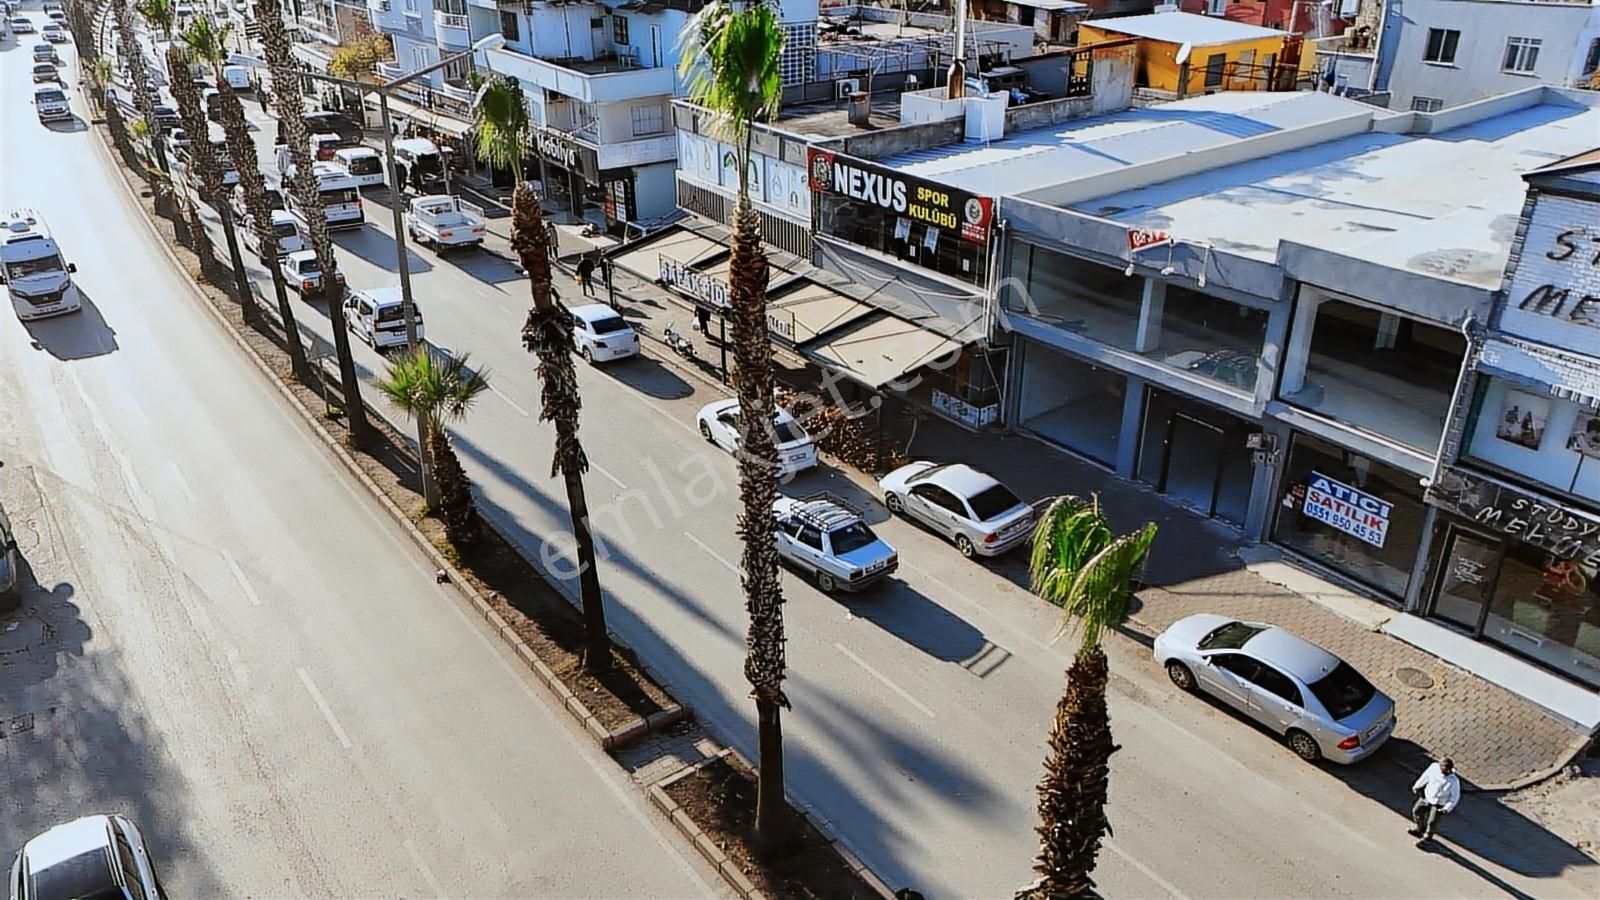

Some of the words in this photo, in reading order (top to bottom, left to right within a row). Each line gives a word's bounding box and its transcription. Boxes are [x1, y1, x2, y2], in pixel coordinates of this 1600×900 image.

[833, 162, 908, 213] NEXUS
[917, 187, 949, 207] SPOR
[1308, 490, 1384, 532] SATILIK
[1312, 478, 1390, 518] ATICI
[1306, 502, 1330, 521] 0551
[1332, 514, 1351, 530] 950
[1352, 523, 1366, 537] 45
[1367, 530, 1382, 544] 53
[1511, 499, 1600, 540] STUDY
